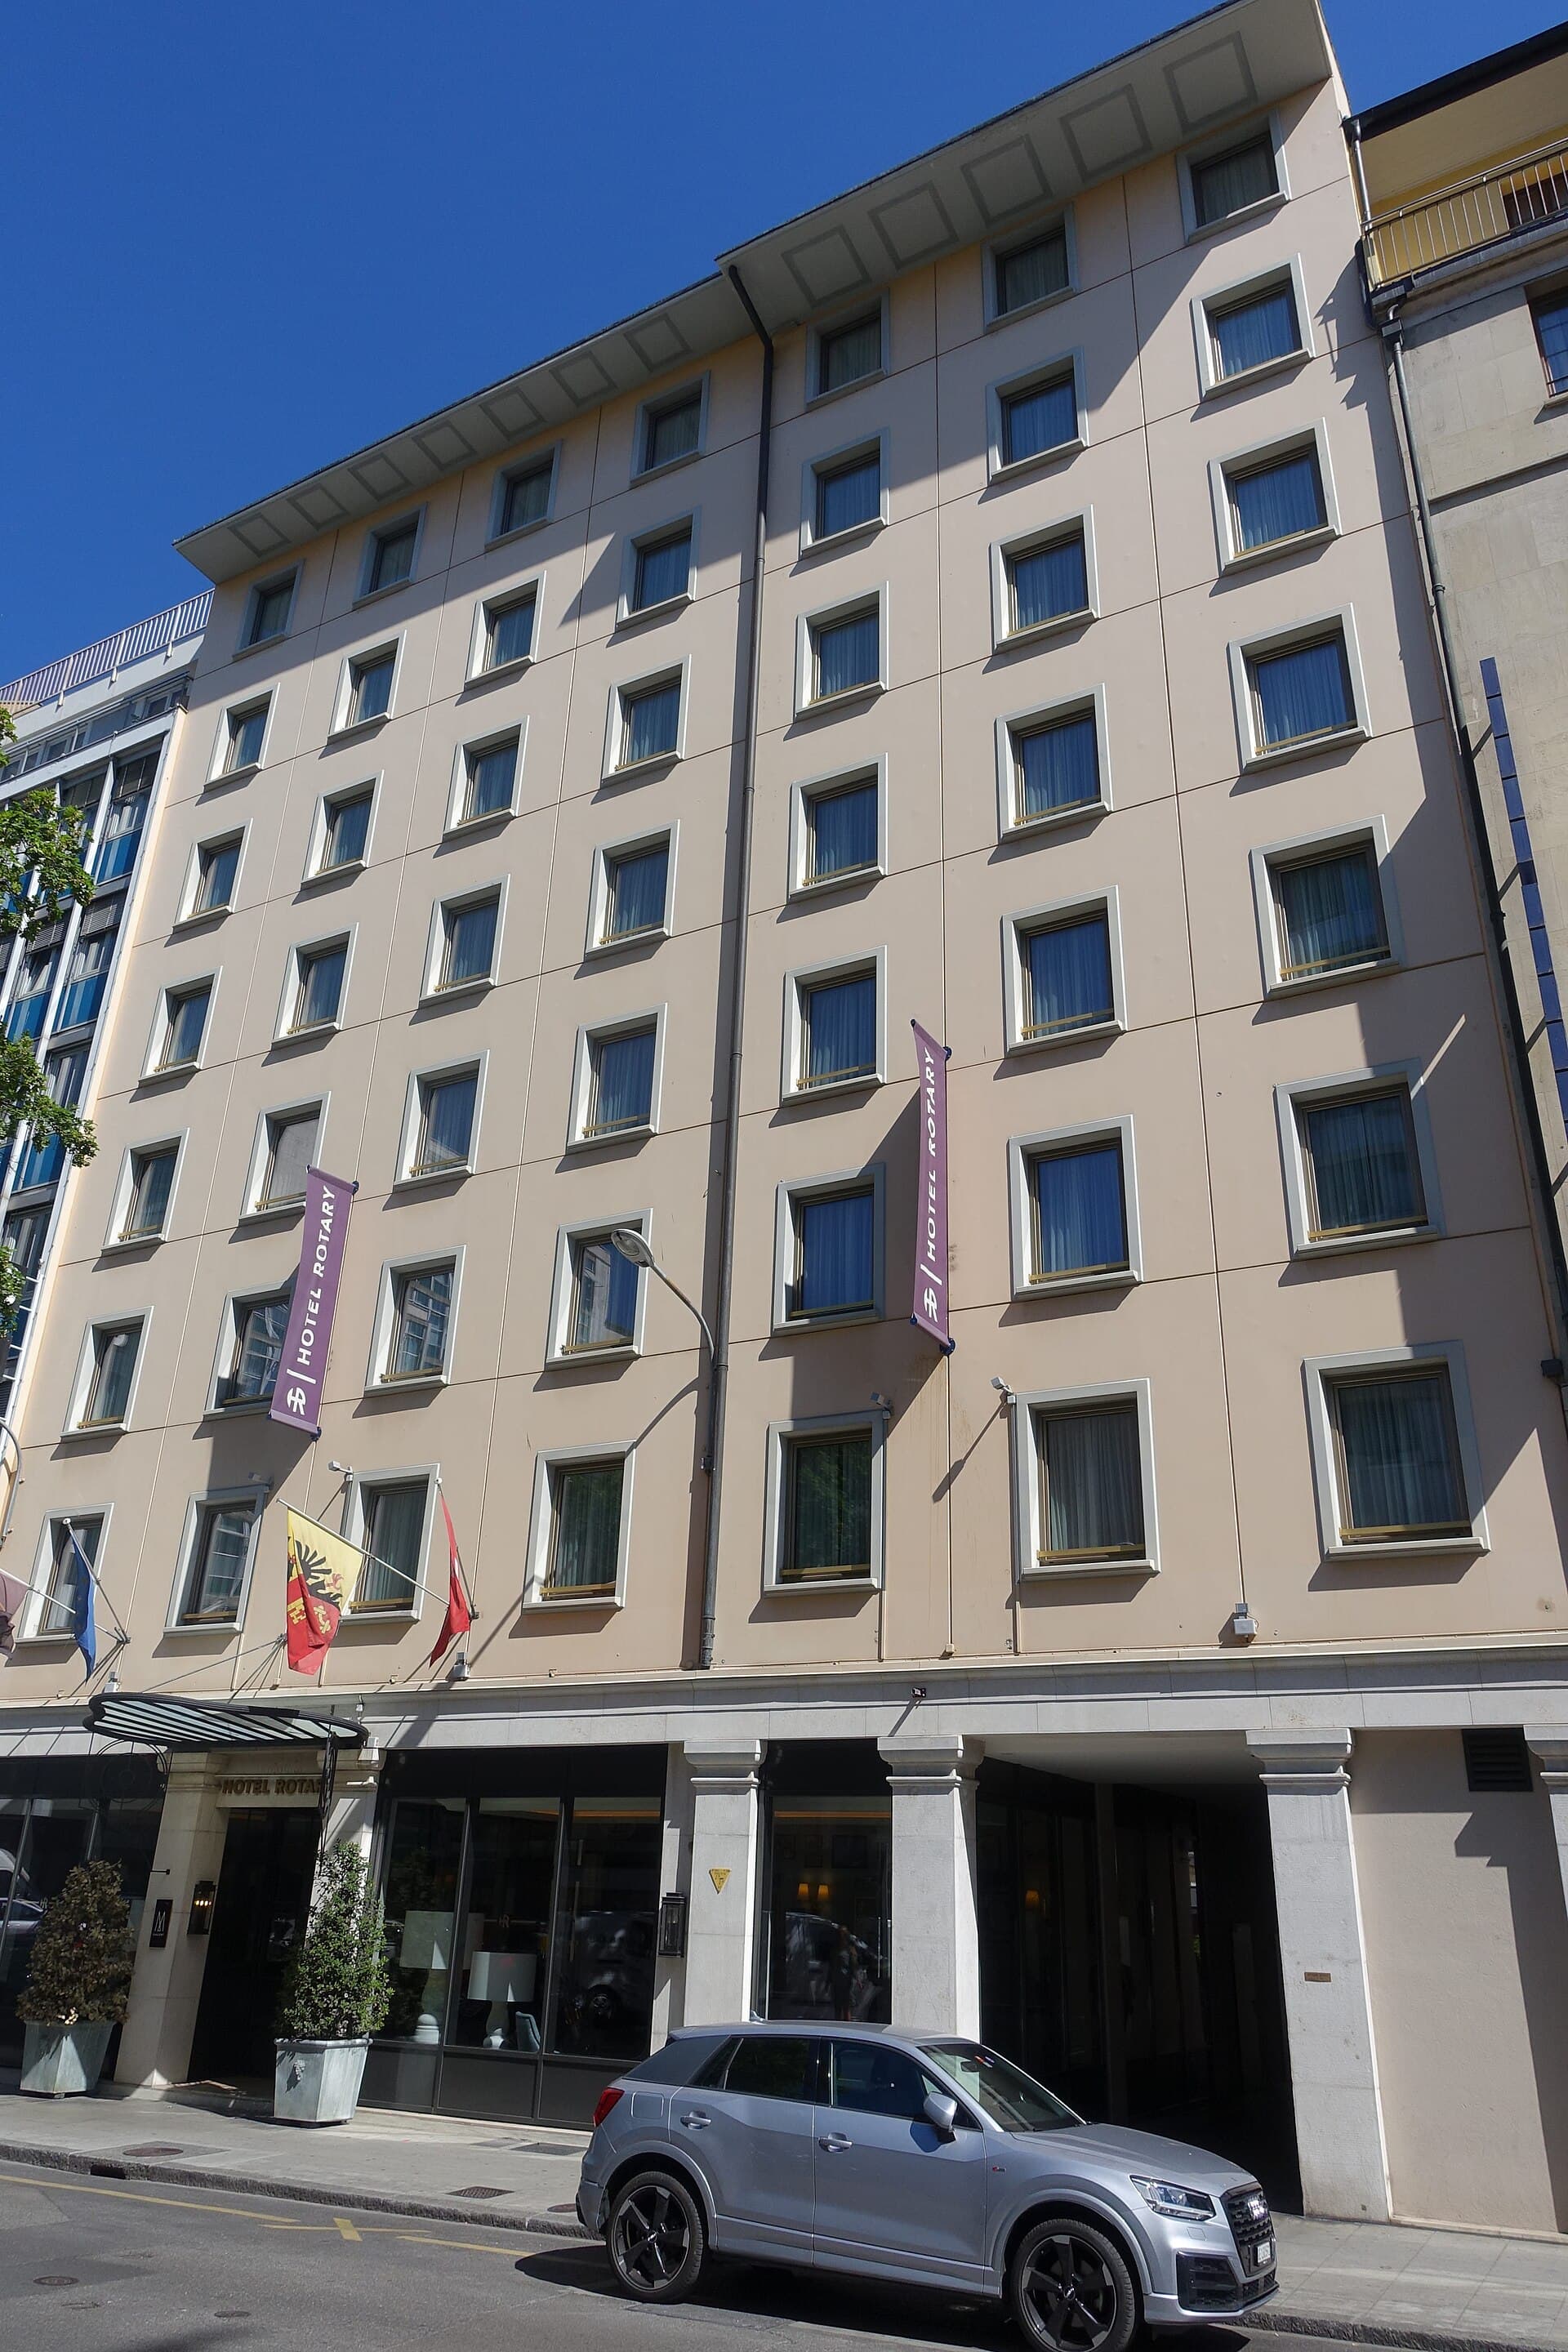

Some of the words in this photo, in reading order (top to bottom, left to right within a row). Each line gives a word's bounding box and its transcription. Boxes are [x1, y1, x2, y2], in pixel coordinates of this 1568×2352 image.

[924, 1046, 936, 1157] ROTARY
[927, 1169, 937, 1262] HOTEL
[296, 1288, 322, 1366] HOTEL
[313, 1185, 336, 1278] ROTARY
[221, 1779, 270, 1795] HOTEL
[274, 1778, 321, 1794] ROTA
